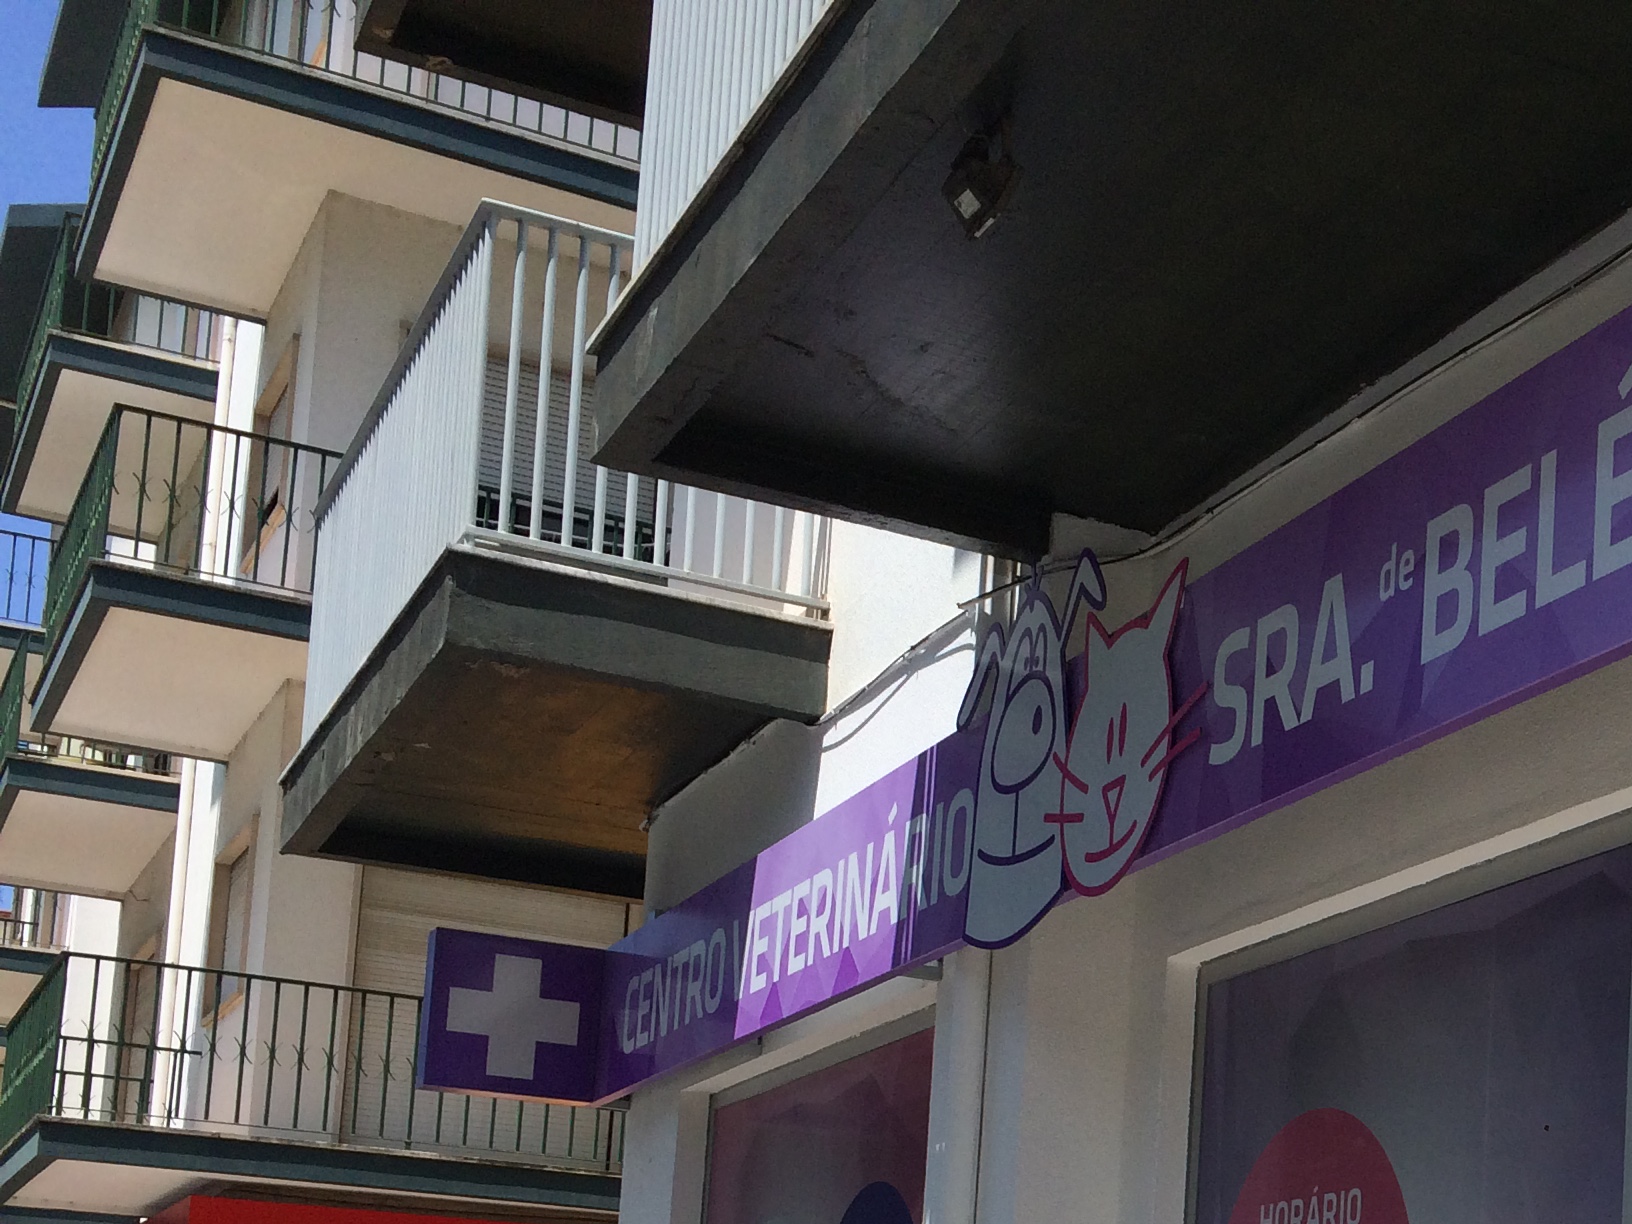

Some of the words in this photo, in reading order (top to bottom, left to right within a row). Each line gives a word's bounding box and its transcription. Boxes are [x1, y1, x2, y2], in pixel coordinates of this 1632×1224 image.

[621, 927, 727, 1055] CENTRO
[731, 788, 974, 999] VETERINÁRIO
[1208, 572, 1374, 766] SRA.
[1378, 542, 1415, 603] de
